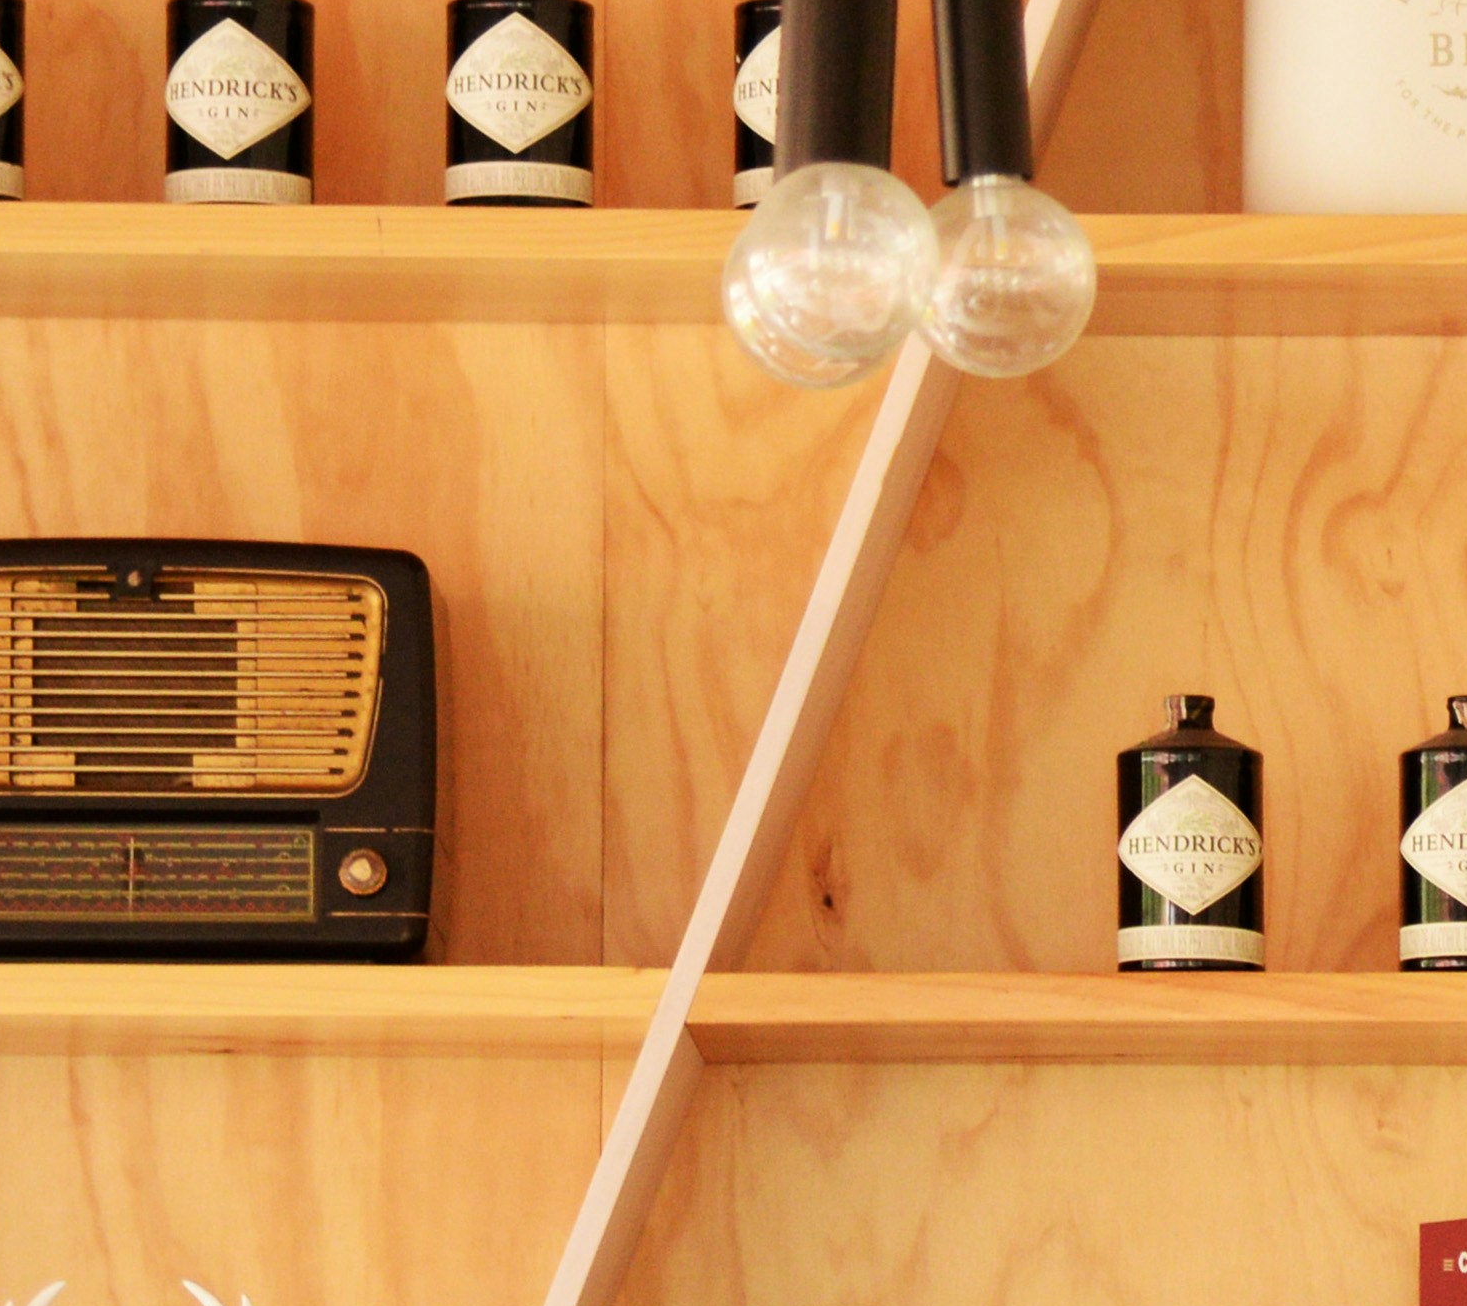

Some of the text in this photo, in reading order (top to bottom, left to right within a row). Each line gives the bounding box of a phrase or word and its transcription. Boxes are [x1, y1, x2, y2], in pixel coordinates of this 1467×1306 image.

[168, 77, 300, 103] HENDRICK'S
[454, 72, 583, 97] HENDRICK'S
[207, 104, 252, 119] GIN
[495, 99, 539, 113] GIN
[1394, 78, 1420, 112] FOR
[1421, 108, 1454, 137] THE
[1128, 833, 1258, 856] HENDRICK'S
[1172, 861, 1214, 875] GIN
